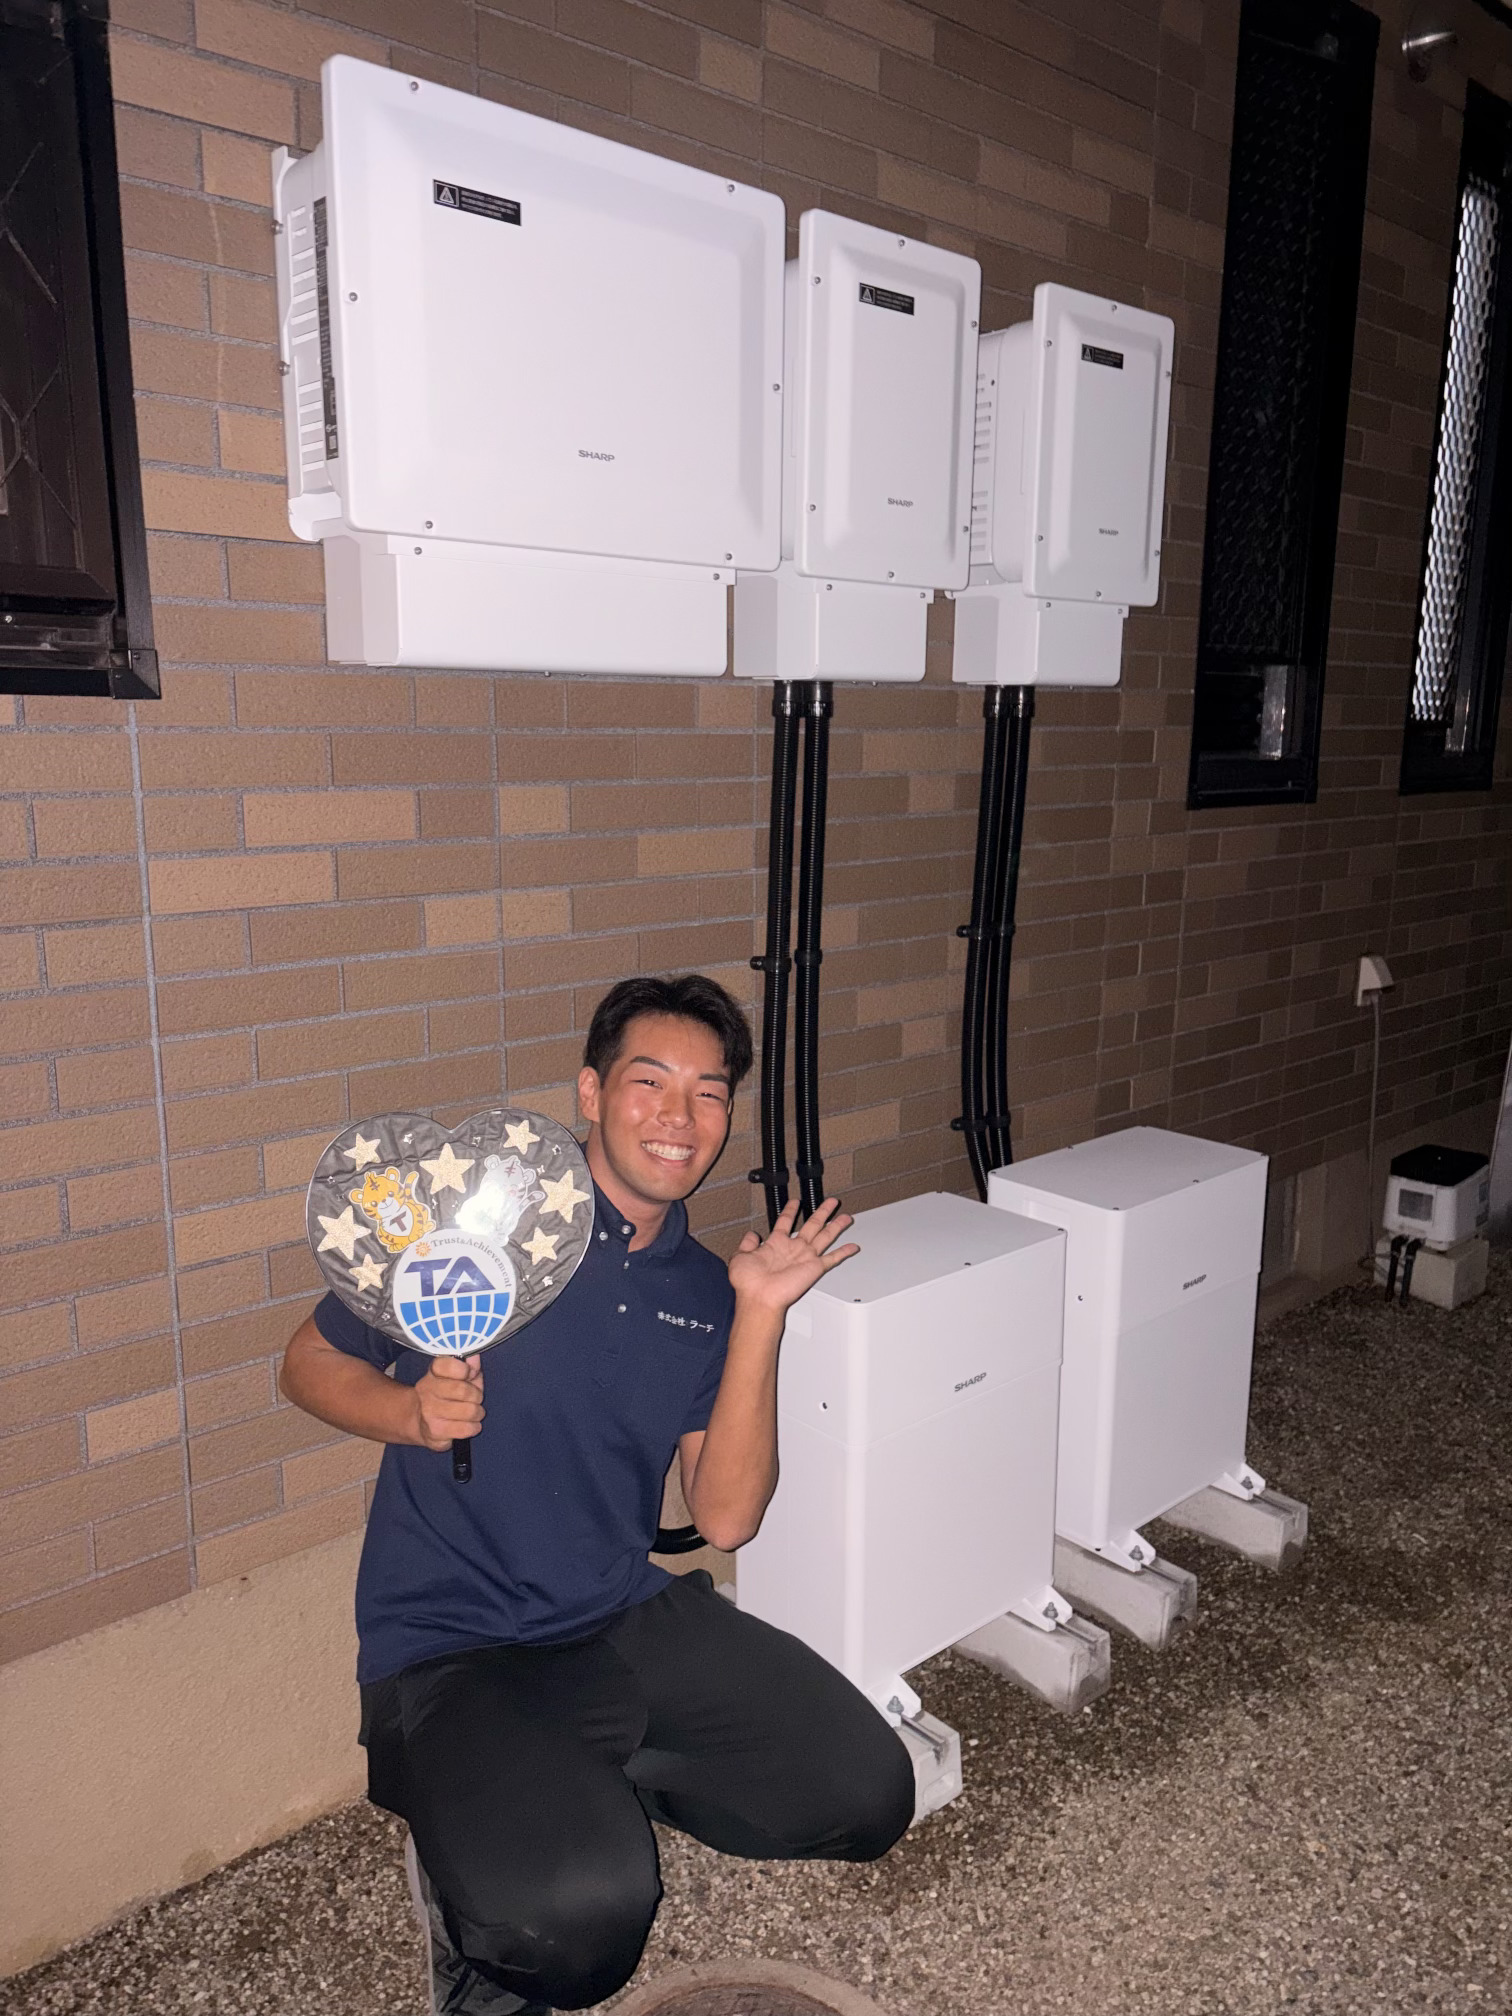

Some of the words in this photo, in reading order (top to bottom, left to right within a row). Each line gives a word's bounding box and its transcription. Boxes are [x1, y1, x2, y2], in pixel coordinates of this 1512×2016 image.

[578, 449, 615, 462] SHARP
[887, 497, 914, 508] SHARP
[403, 1255, 496, 1297] TA
[1182, 1274, 1207, 1290] SHARP
[954, 1371, 987, 1392] SHARP
